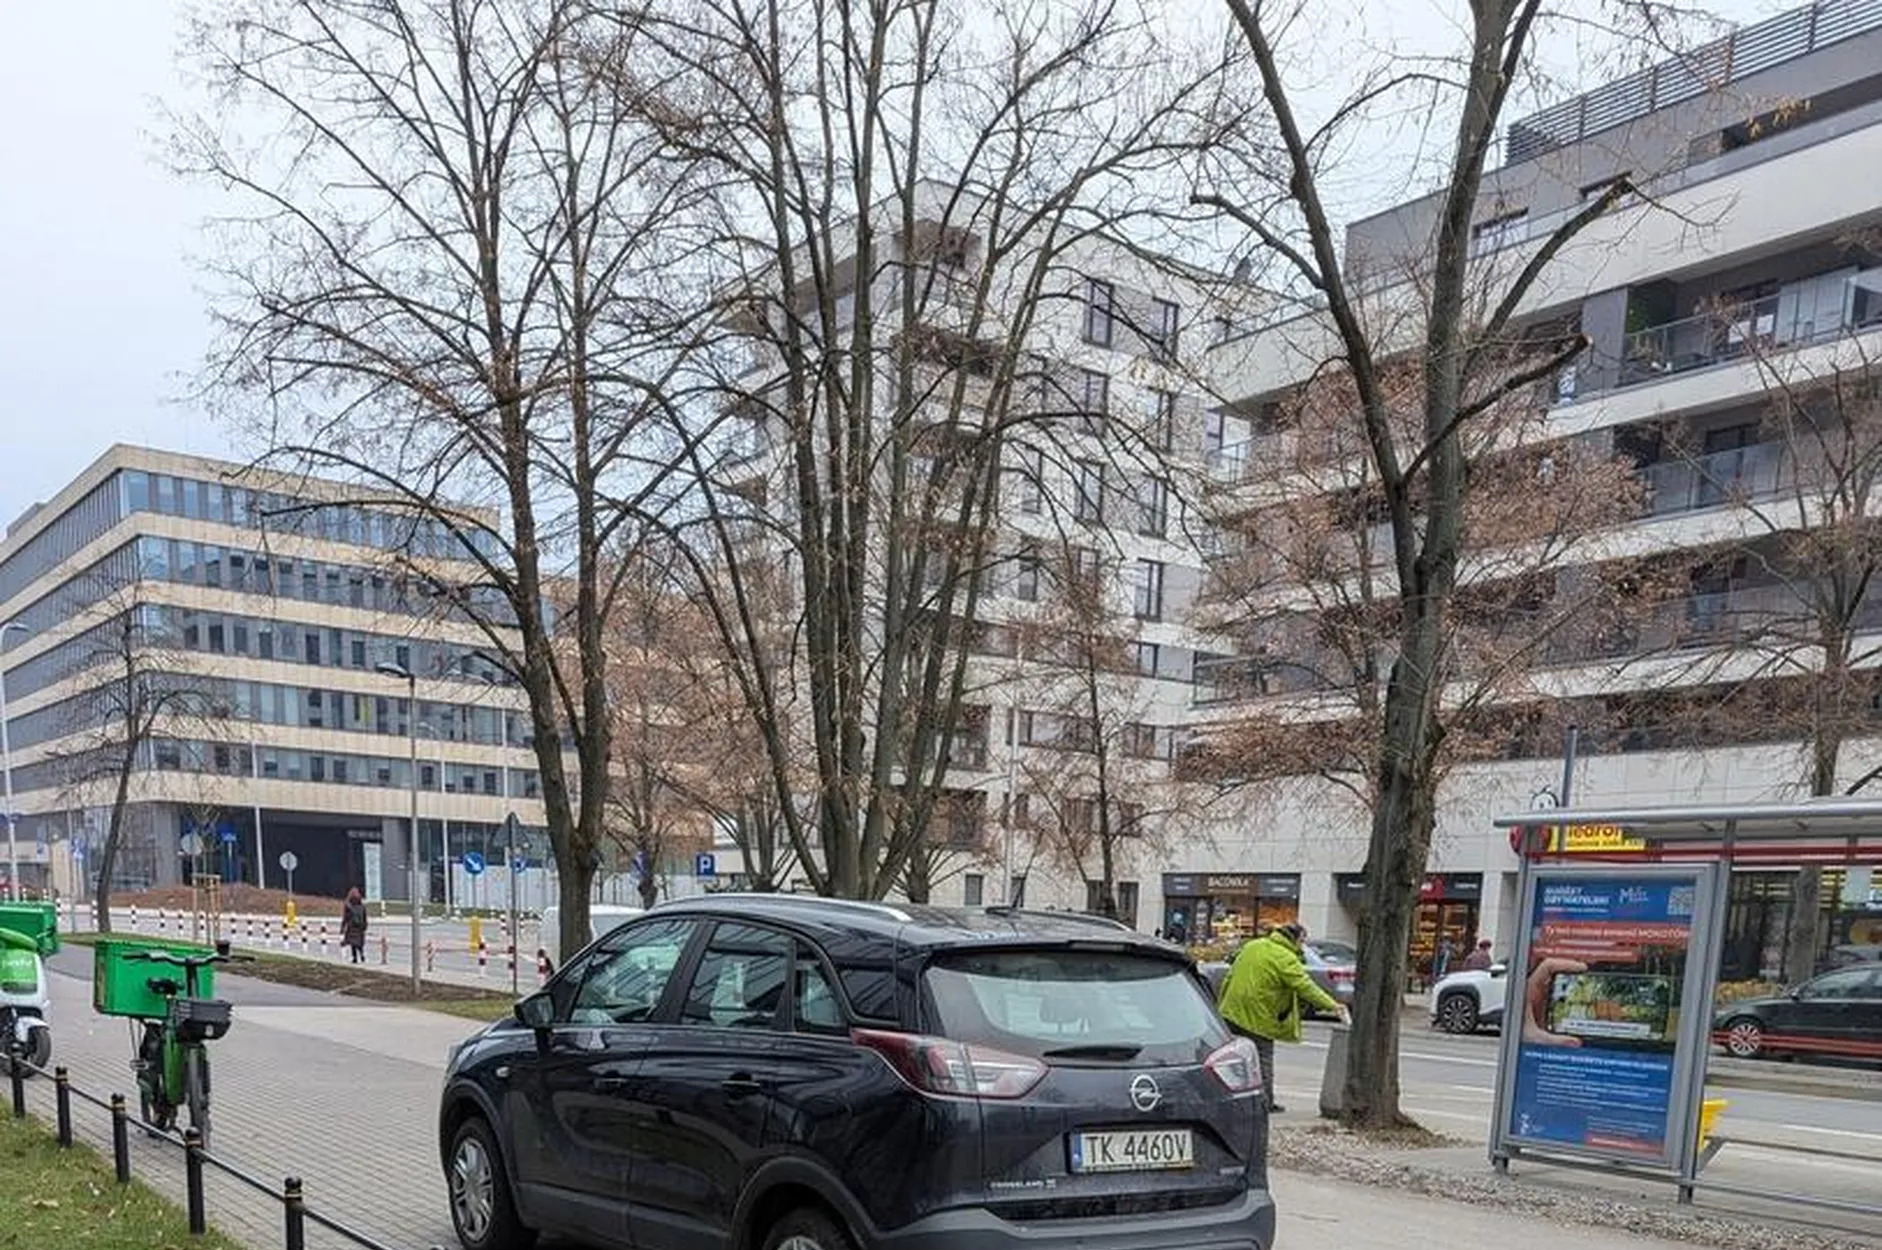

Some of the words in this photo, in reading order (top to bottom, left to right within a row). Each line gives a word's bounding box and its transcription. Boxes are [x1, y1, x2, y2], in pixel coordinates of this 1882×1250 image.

[700, 855, 712, 874] P
[1085, 1135, 1115, 1164] TK
[1123, 1133, 1187, 1163] 4460V
